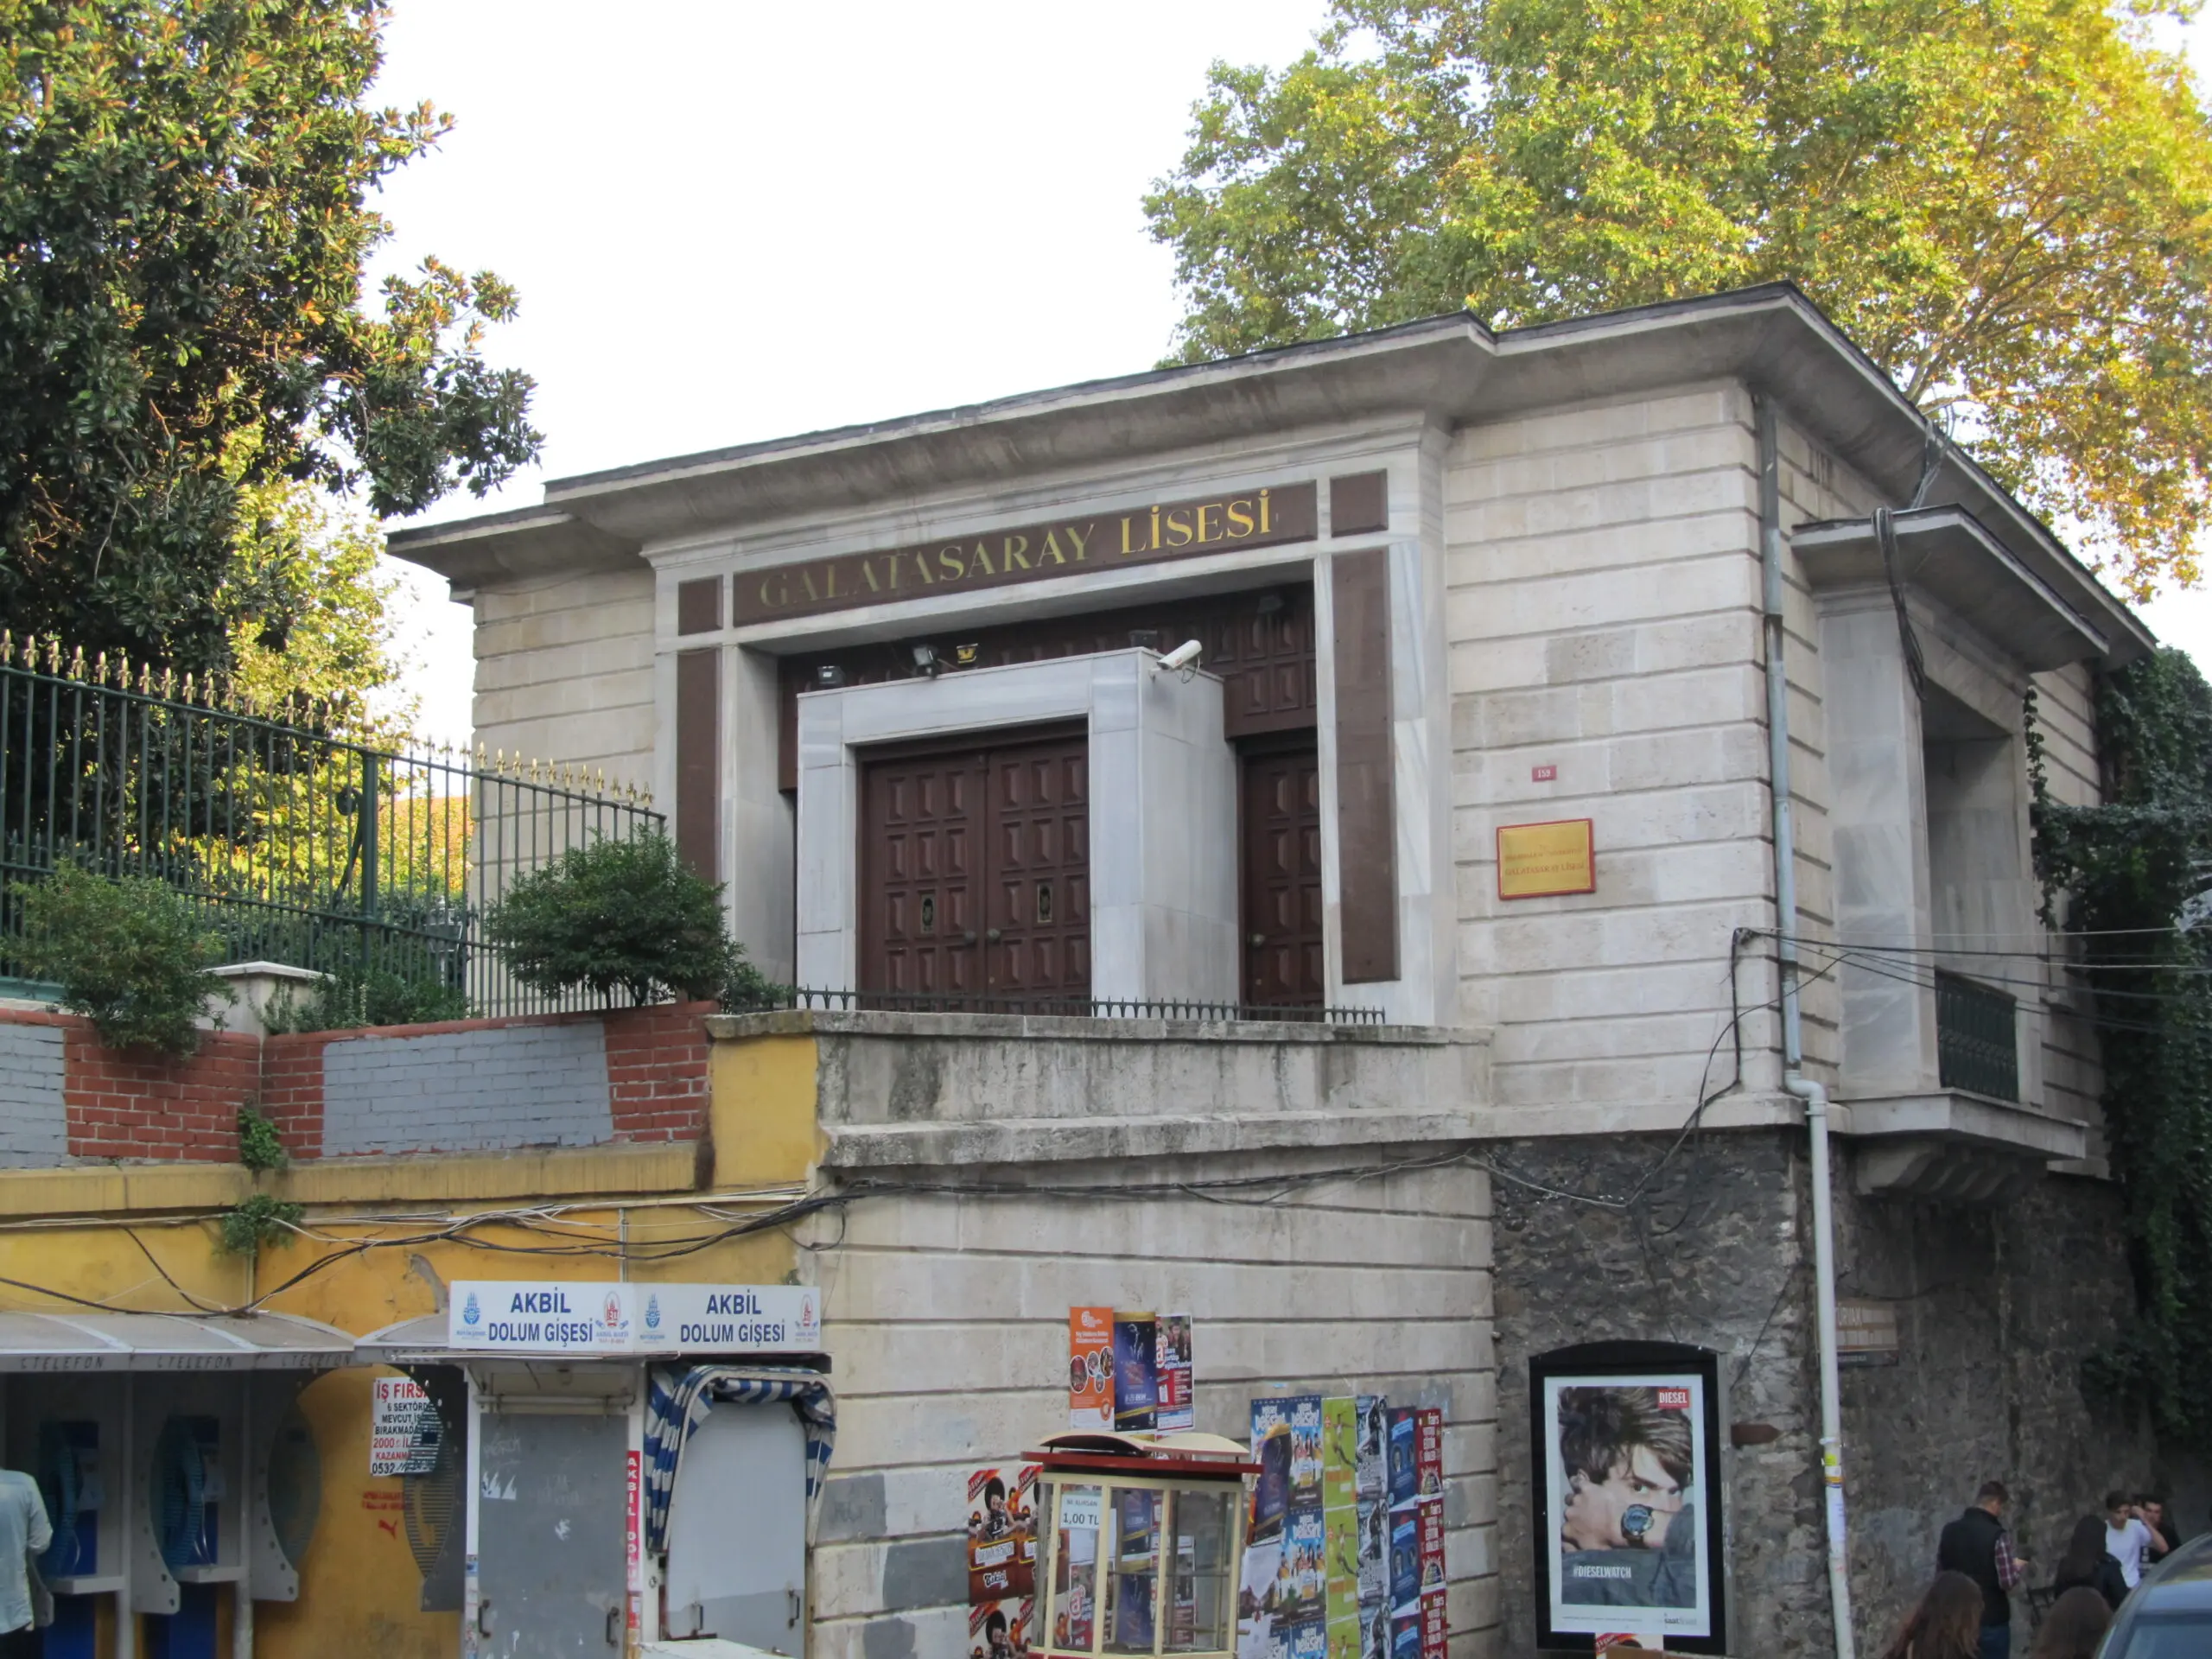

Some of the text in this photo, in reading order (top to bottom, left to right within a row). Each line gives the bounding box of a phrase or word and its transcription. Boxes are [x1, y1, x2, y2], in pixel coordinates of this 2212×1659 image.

[760, 488, 1272, 607] GALATASARAY LİSESİ
[1538, 768, 1551, 778] 159
[511, 1287, 571, 1313] AKBİL
[706, 1289, 762, 1315] AKBİL
[488, 1318, 593, 1347] DOLUM GİŞESİ
[681, 1324, 734, 1343] DOLUM
[738, 1319, 785, 1347] GİŞESİ
[33, 1356, 104, 1370] TELEFON
[168, 1356, 234, 1370] TELEFON
[377, 1380, 389, 1403] İŞ
[1658, 1391, 1688, 1403] DIESEL
[373, 1437, 395, 1448] 2000
[372, 1463, 395, 1474] 0532
[627, 1457, 638, 1516] AKBİL
[1064, 1512, 1099, 1525] 1,00 TL
[1573, 1565, 1632, 1579] #DIESELWATCH
